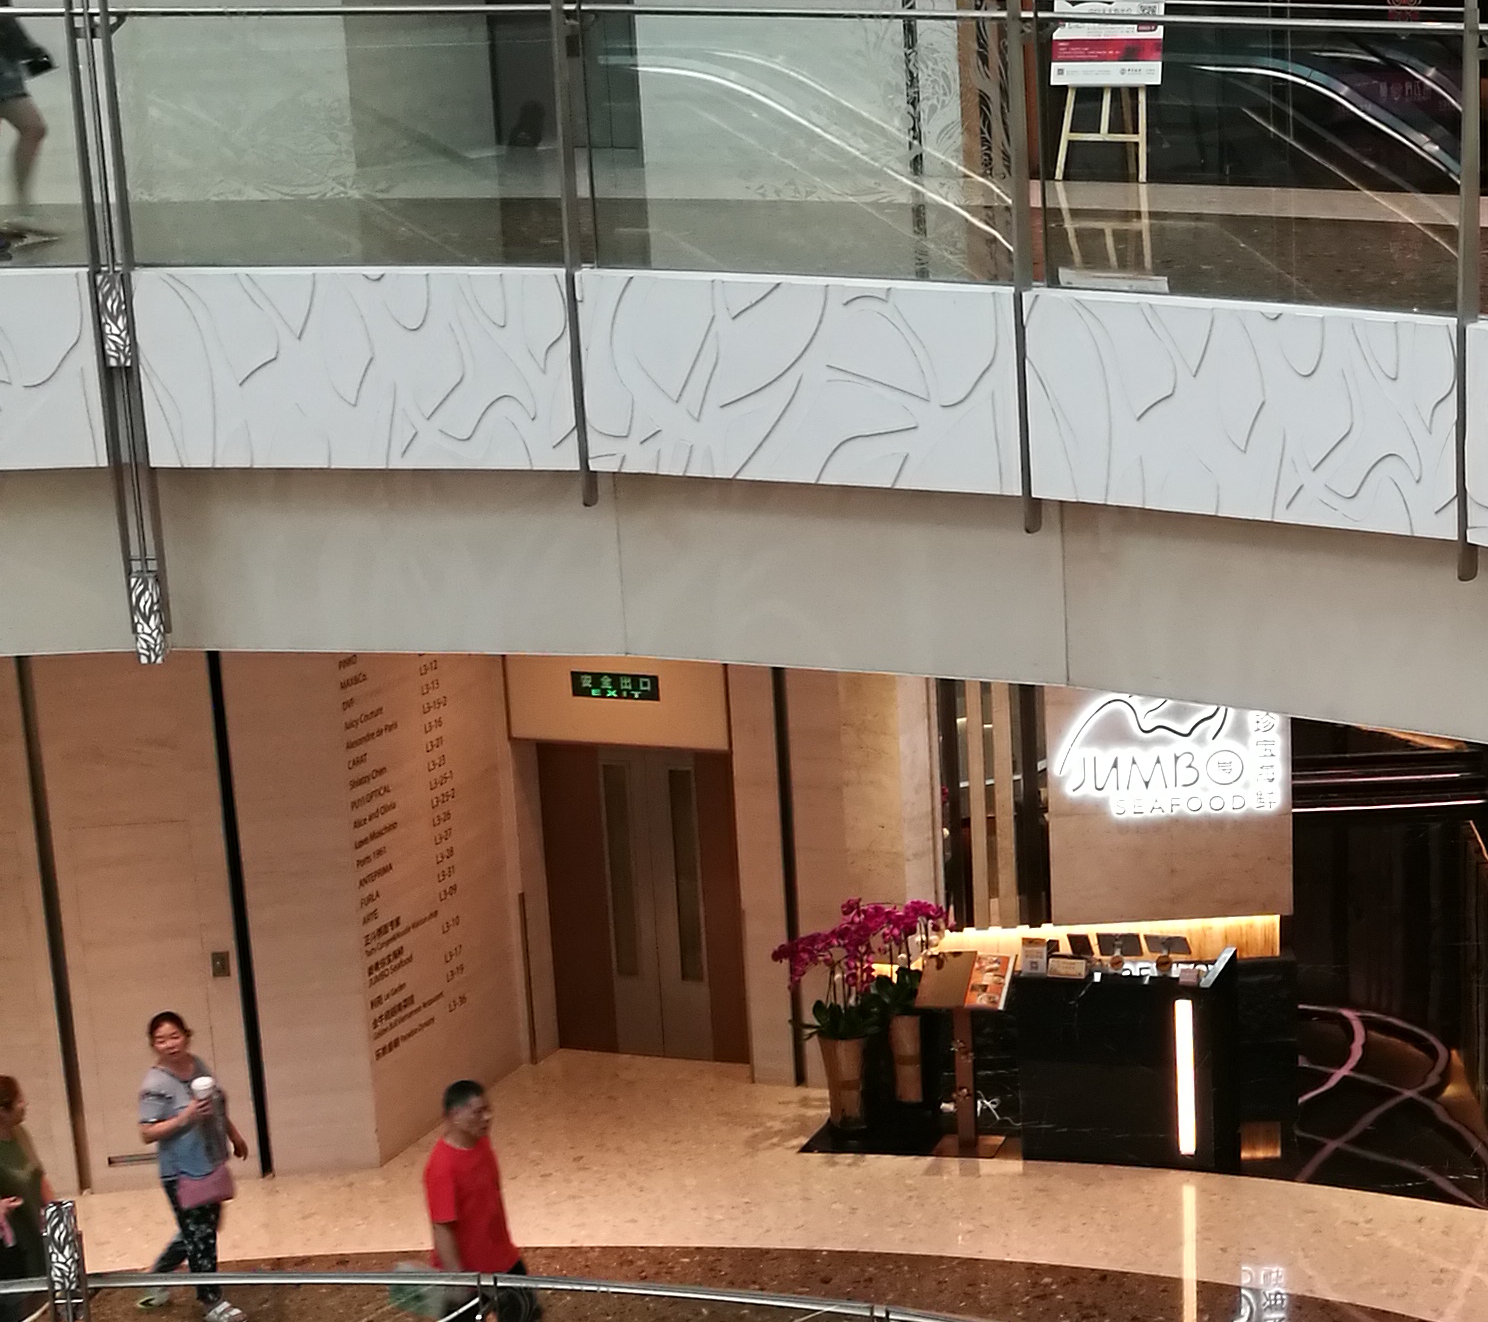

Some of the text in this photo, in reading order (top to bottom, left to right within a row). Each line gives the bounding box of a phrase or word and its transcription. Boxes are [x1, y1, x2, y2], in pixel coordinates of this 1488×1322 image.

[580, 674, 651, 691] 安全出口
[590, 688, 642, 698] EXIT
[1072, 750, 1244, 793] JUMBO
[1114, 794, 1246, 816] SEAFOOD
